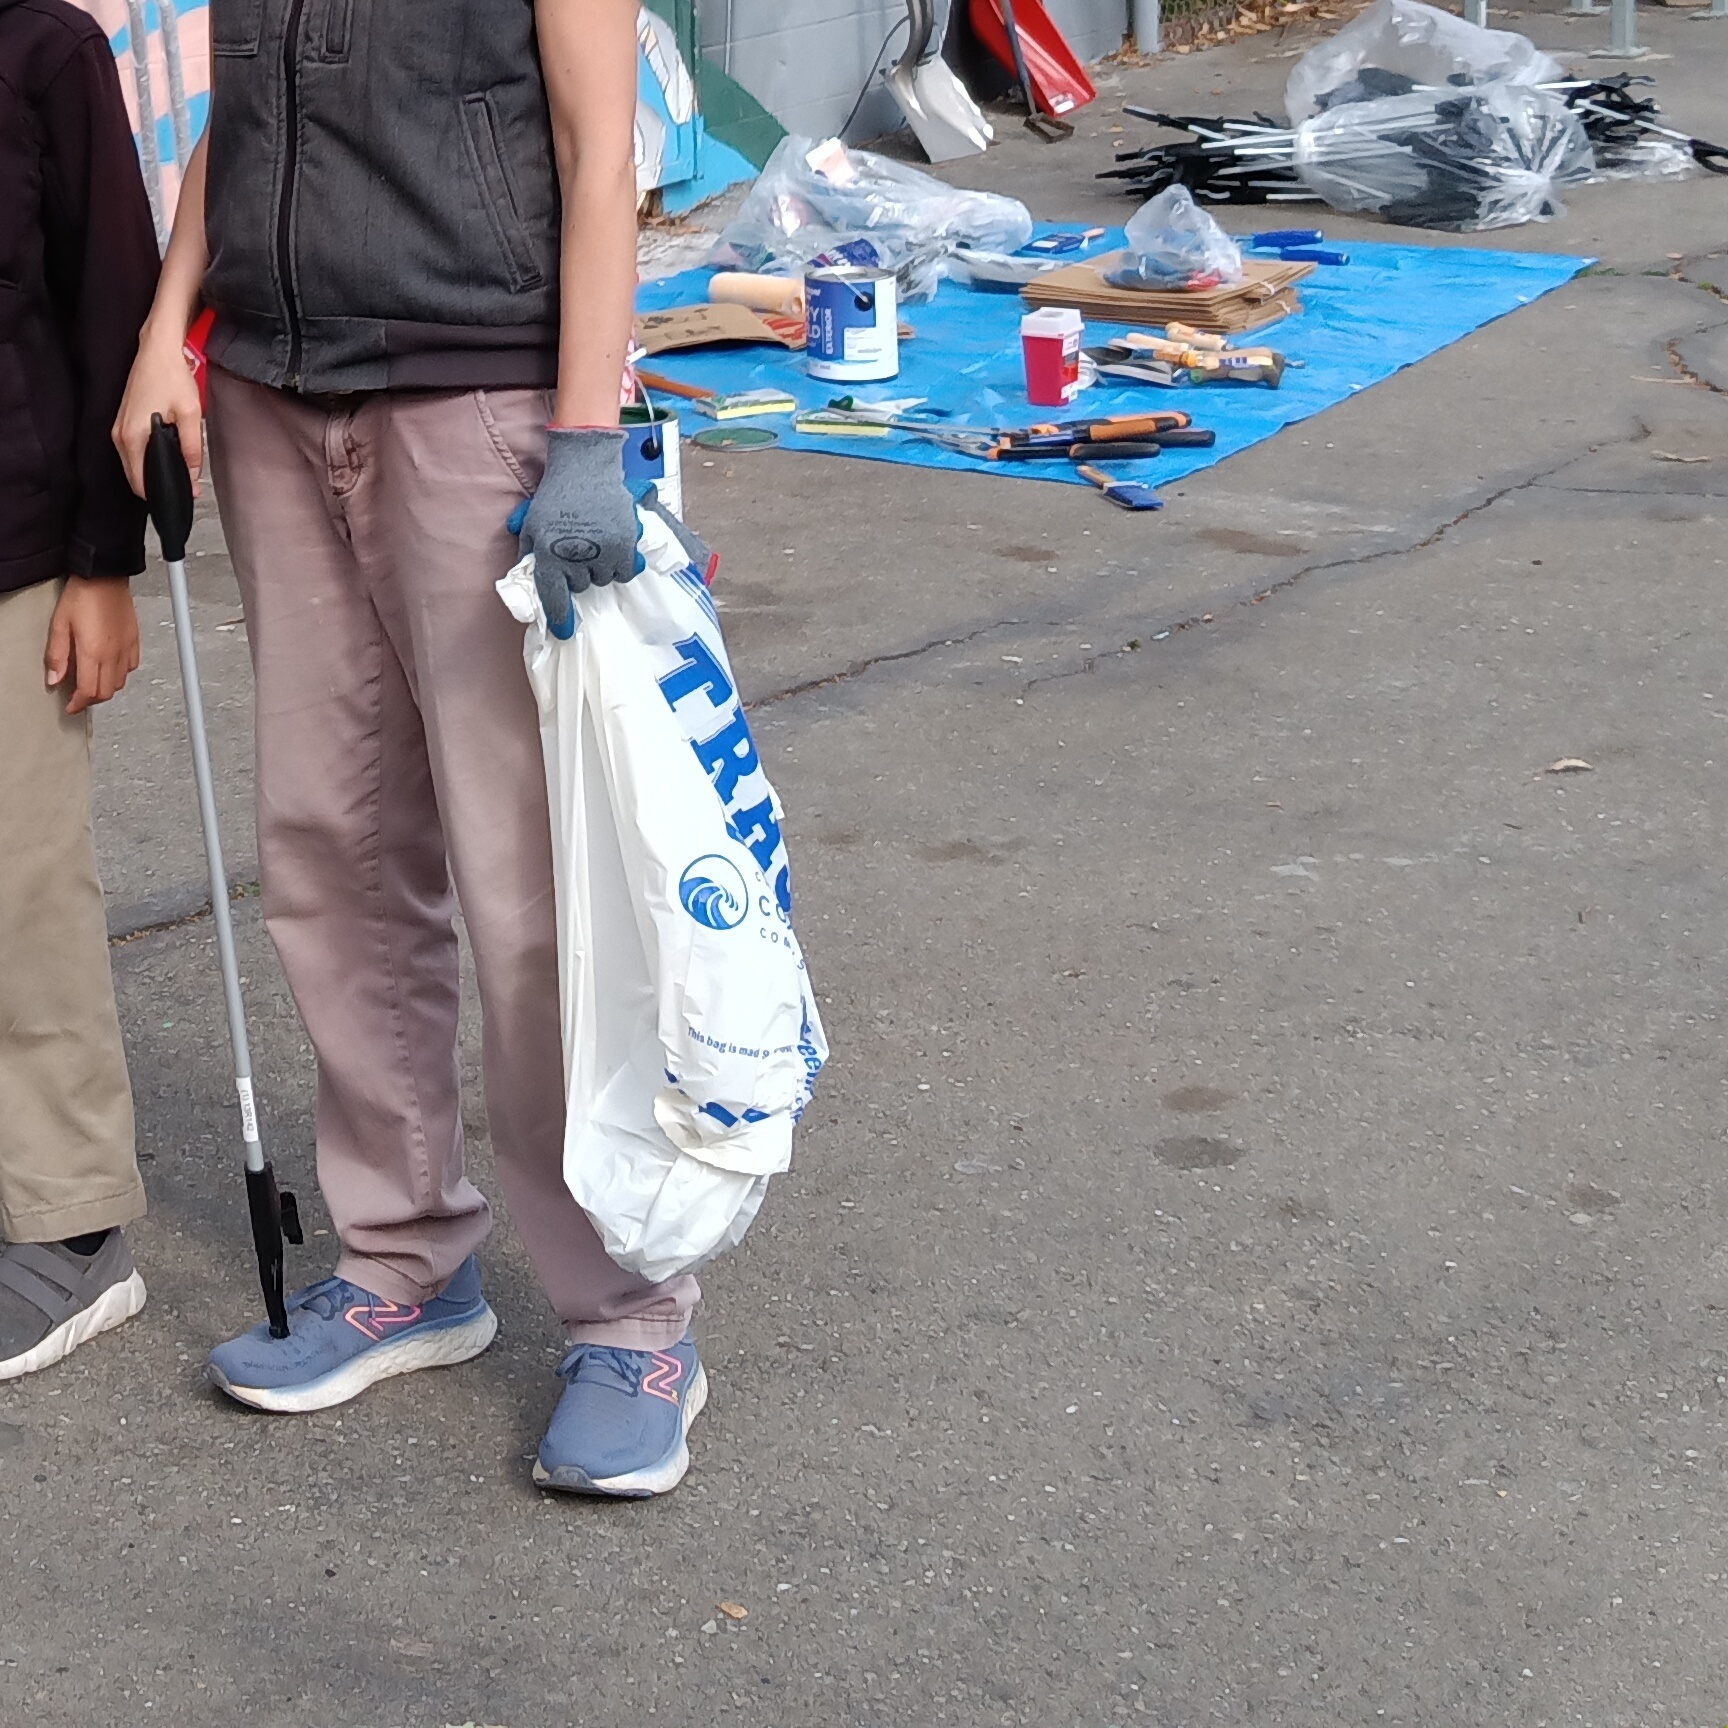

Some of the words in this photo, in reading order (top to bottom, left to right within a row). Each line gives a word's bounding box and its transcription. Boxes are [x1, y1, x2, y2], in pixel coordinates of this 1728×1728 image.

[687, 1026, 704, 1043] This
[706, 1035, 726, 1053] bag
[728, 1042, 736, 1053] is
